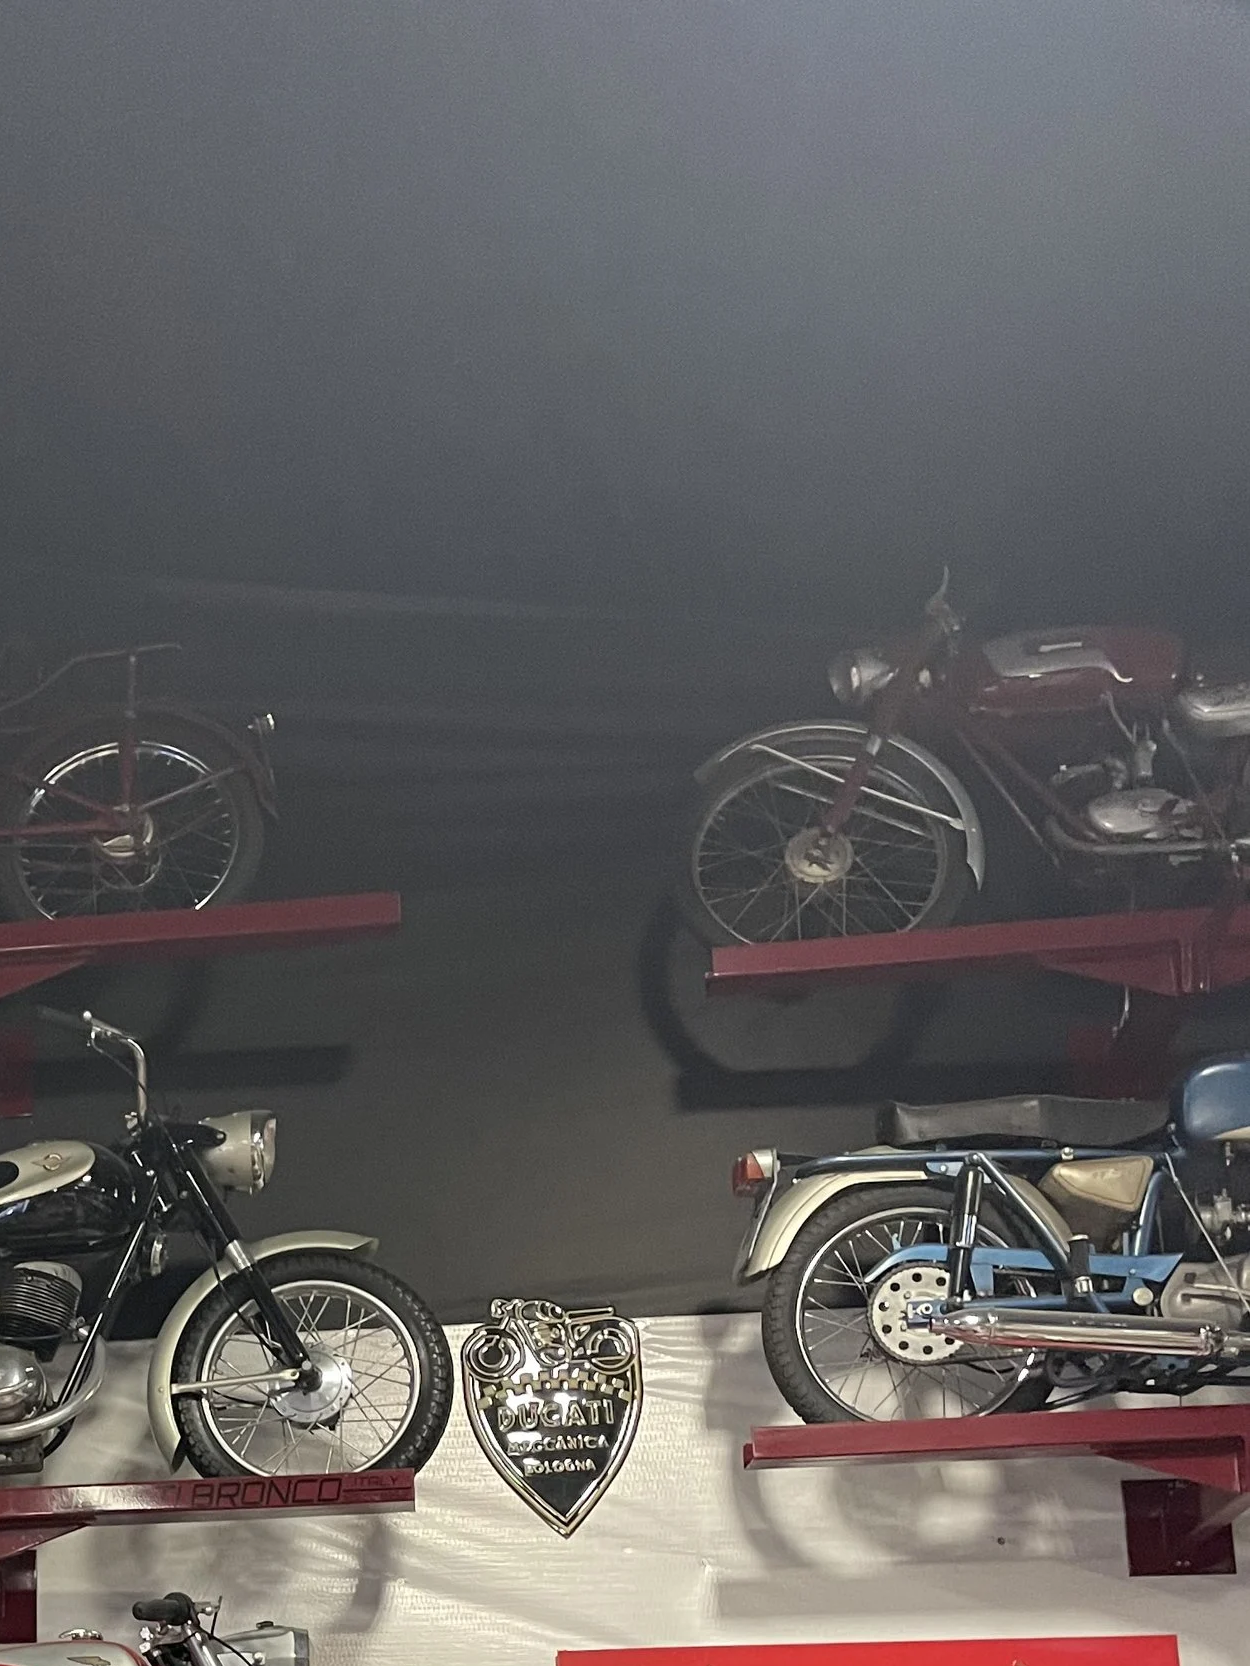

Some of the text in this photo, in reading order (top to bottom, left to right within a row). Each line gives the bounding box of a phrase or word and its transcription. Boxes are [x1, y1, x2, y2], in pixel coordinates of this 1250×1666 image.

[498, 1399, 615, 1432] DUCATI
[524, 1458, 597, 1477] BOLOGNA
[190, 1477, 342, 1508] BRONCO
